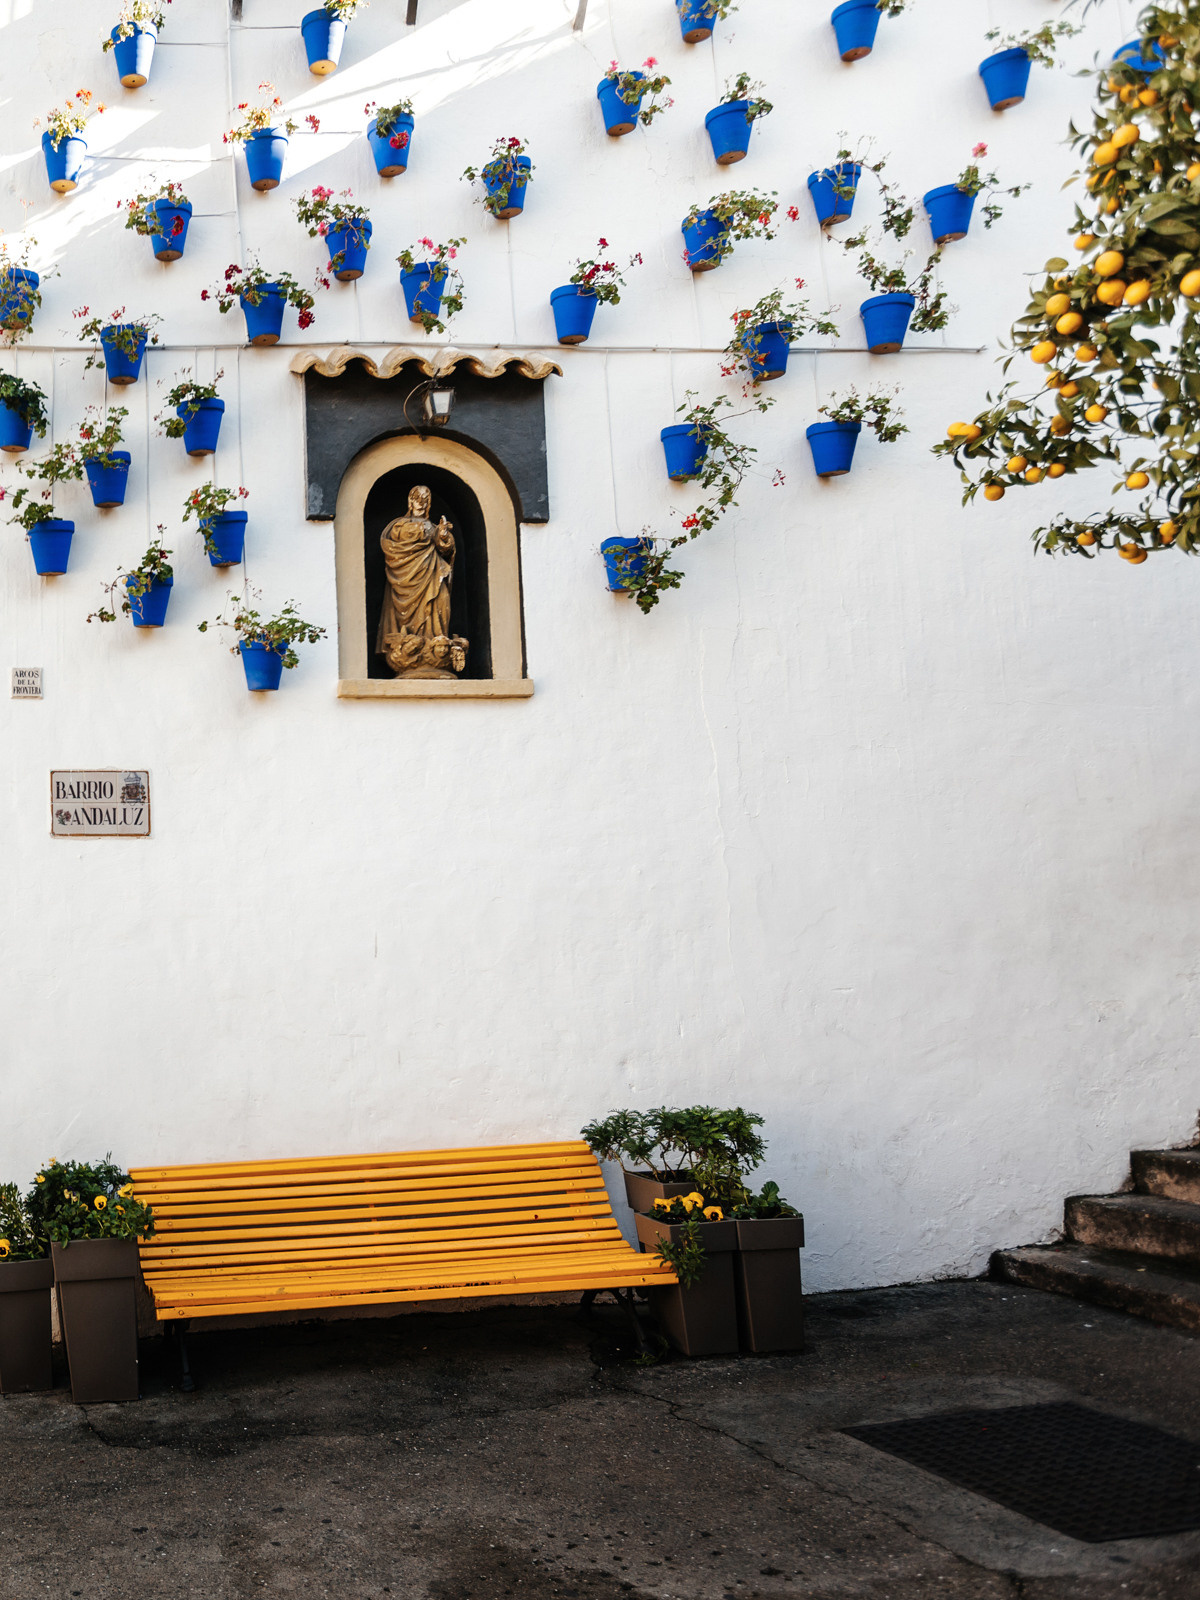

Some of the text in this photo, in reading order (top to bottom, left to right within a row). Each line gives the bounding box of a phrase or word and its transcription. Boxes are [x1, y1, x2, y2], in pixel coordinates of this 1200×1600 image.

[14, 670, 39, 678] ARCOS
[13, 686, 41, 695] FRONTERA
[55, 781, 114, 800] BARRIO
[70, 807, 144, 826] ANDALUZ
